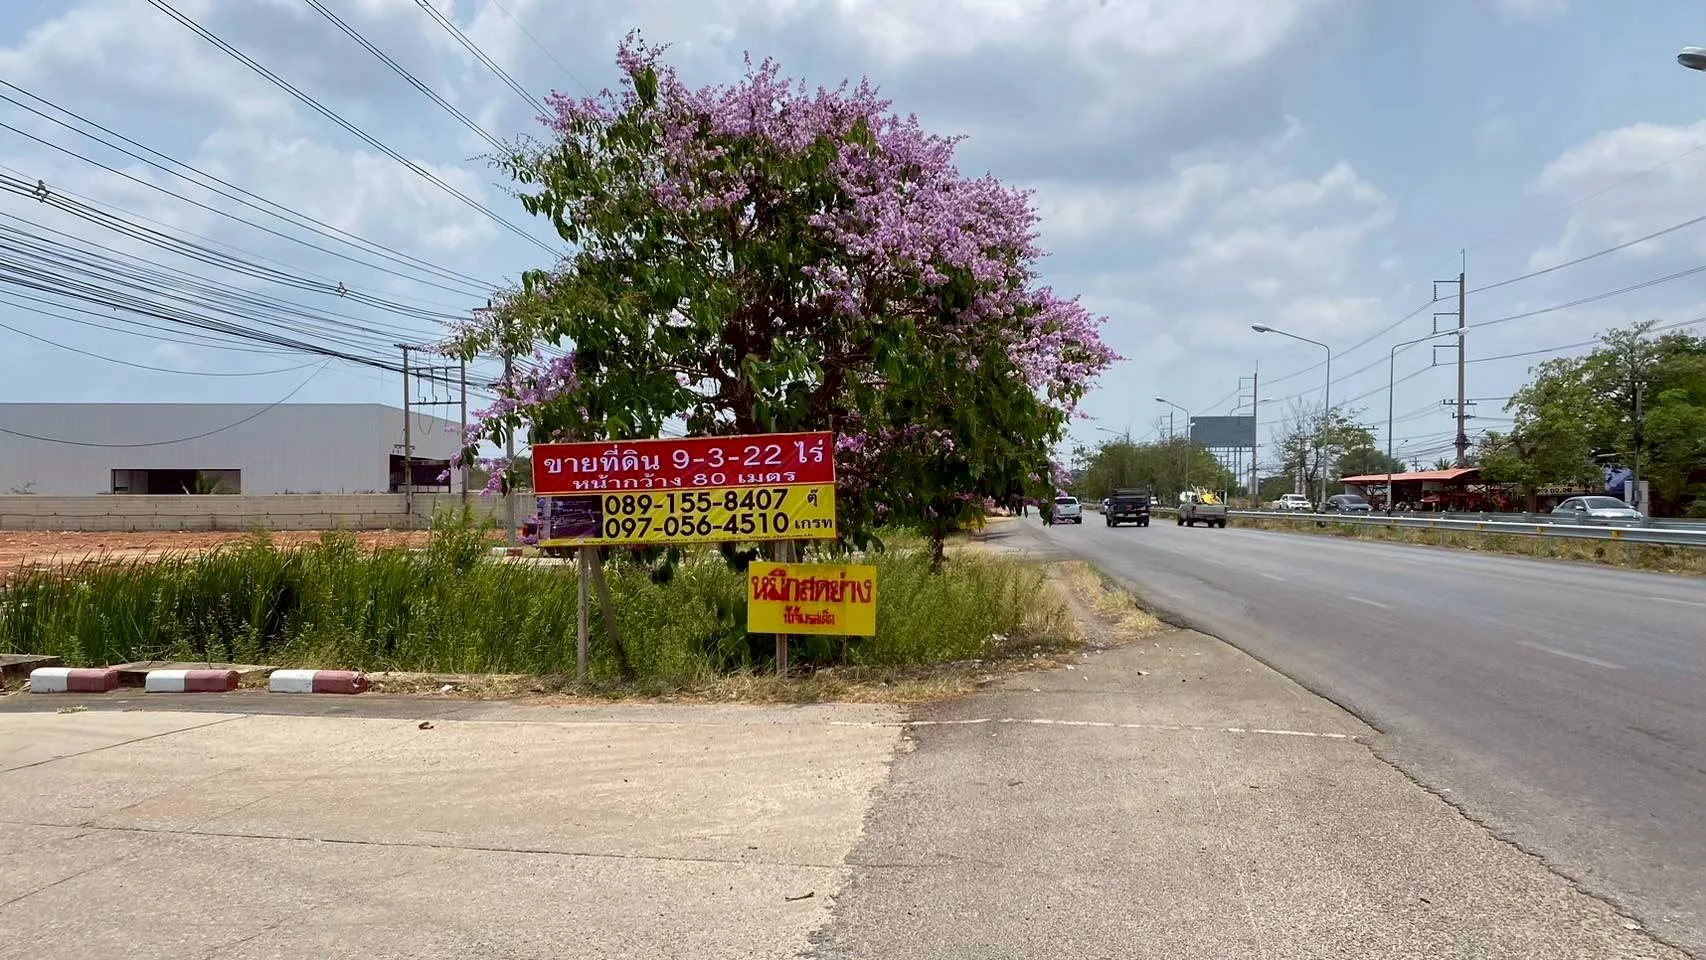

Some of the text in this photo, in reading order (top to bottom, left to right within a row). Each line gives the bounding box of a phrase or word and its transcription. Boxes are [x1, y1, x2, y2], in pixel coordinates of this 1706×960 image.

[543, 439, 824, 474] ขายที่ดิน 9-3-22 ไร่
[572, 471, 797, 490] หน้ากว้าง 80 เมตร
[605, 488, 788, 515] 089-155-8407
[605, 512, 833, 538] 097-056-4510 เกรท
[751, 568, 872, 603] หมึกสดย่าง
